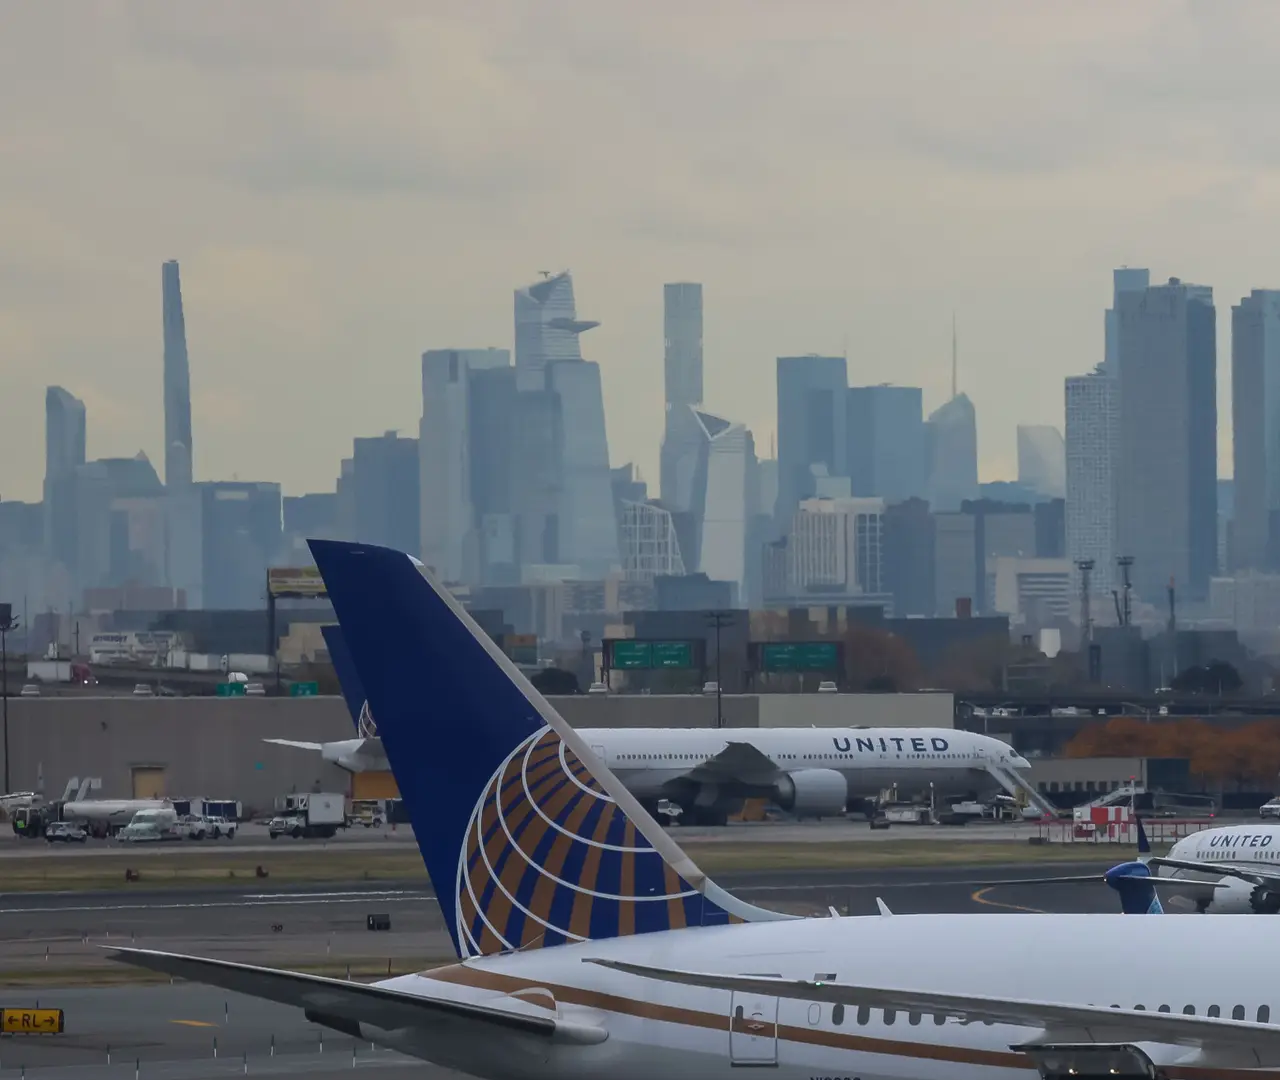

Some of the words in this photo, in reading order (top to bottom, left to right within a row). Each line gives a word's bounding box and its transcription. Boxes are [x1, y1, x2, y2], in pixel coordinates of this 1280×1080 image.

[832, 737, 949, 753] UNITED
[1210, 835, 1273, 848] UNITED
[21, 1014, 41, 1030] RL
